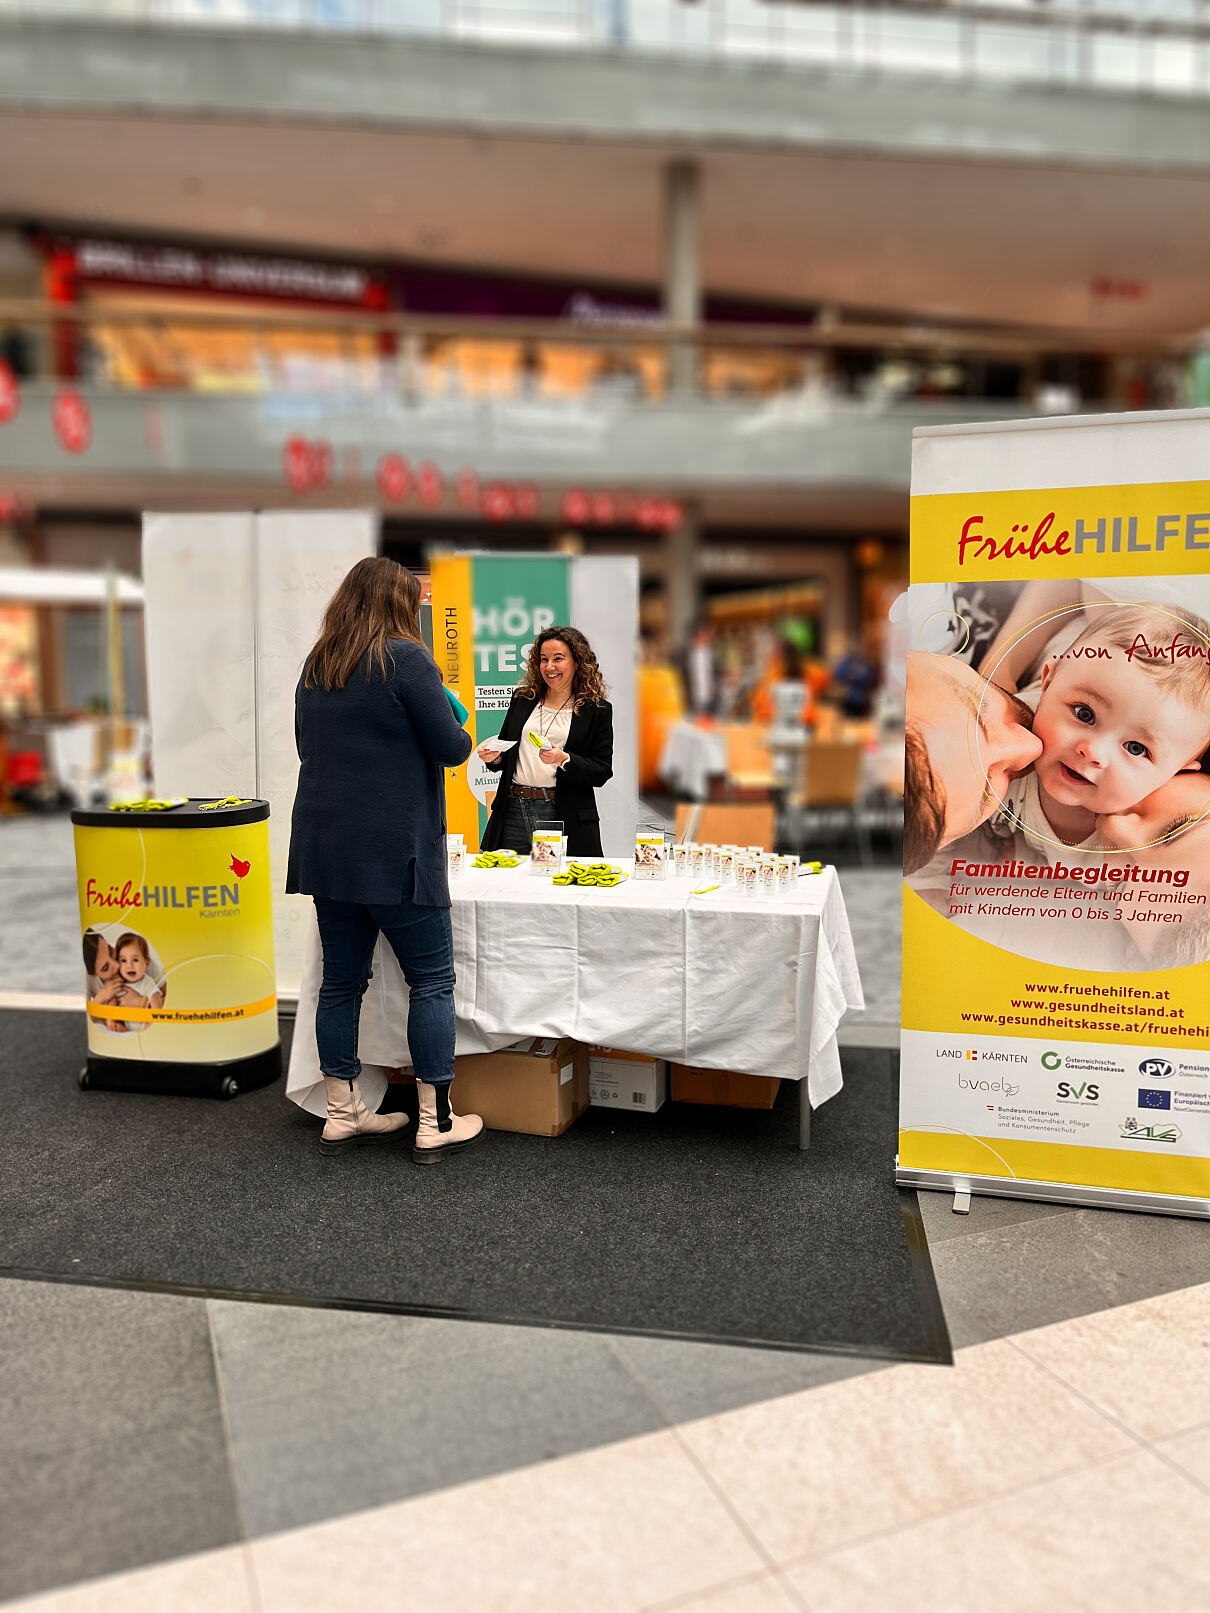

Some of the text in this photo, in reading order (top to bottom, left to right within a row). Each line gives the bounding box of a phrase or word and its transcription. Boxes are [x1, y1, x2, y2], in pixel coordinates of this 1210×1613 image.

[472, 597, 555, 637] HÖR
[445, 607, 459, 684] NEUROTH
[478, 688, 505, 696] Testen
[478, 700, 496, 708] Ihre
[950, 859, 1190, 888] Familienbegleitung
[86, 878, 240, 908] FrüheHILFEN
[950, 883, 1207, 905] für werdende Eltern und Familien
[199, 908, 240, 919] Kärnten
[949, 902, 974, 915] mit
[977, 903, 1036, 917] Kindern
[1039, 906, 1067, 919] von
[1086, 906, 1110, 920] bis
[1112, 908, 1123, 921] 3
[1126, 909, 1183, 923] Jahren
[1025, 982, 1170, 1001] www.fruehehilfen.at
[151, 1008, 244, 1021] www.fruehehilfen.at
[1011, 998, 1185, 1018] www.gesundheitsland.at
[961, 1011, 1209, 1038] www.gesundheitskasse.at/fruehehi
[936, 1049, 1028, 1064] LAND KÄRNTEN
[1065, 1055, 1116, 1066] Österreichische
[1065, 1062, 1125, 1073] Gesundheitskasse
[1145, 1062, 1172, 1077] PV
[958, 1073, 1013, 1093] bvaeb
[1174, 1090, 1207, 1098] Finanziert
[998, 1106, 1060, 1117] Bundesministerium
[998, 1113, 1090, 1128] Soziales, Gesundheit, Pflege
[1011, 1122, 1077, 1134] Konsumentenschutz
